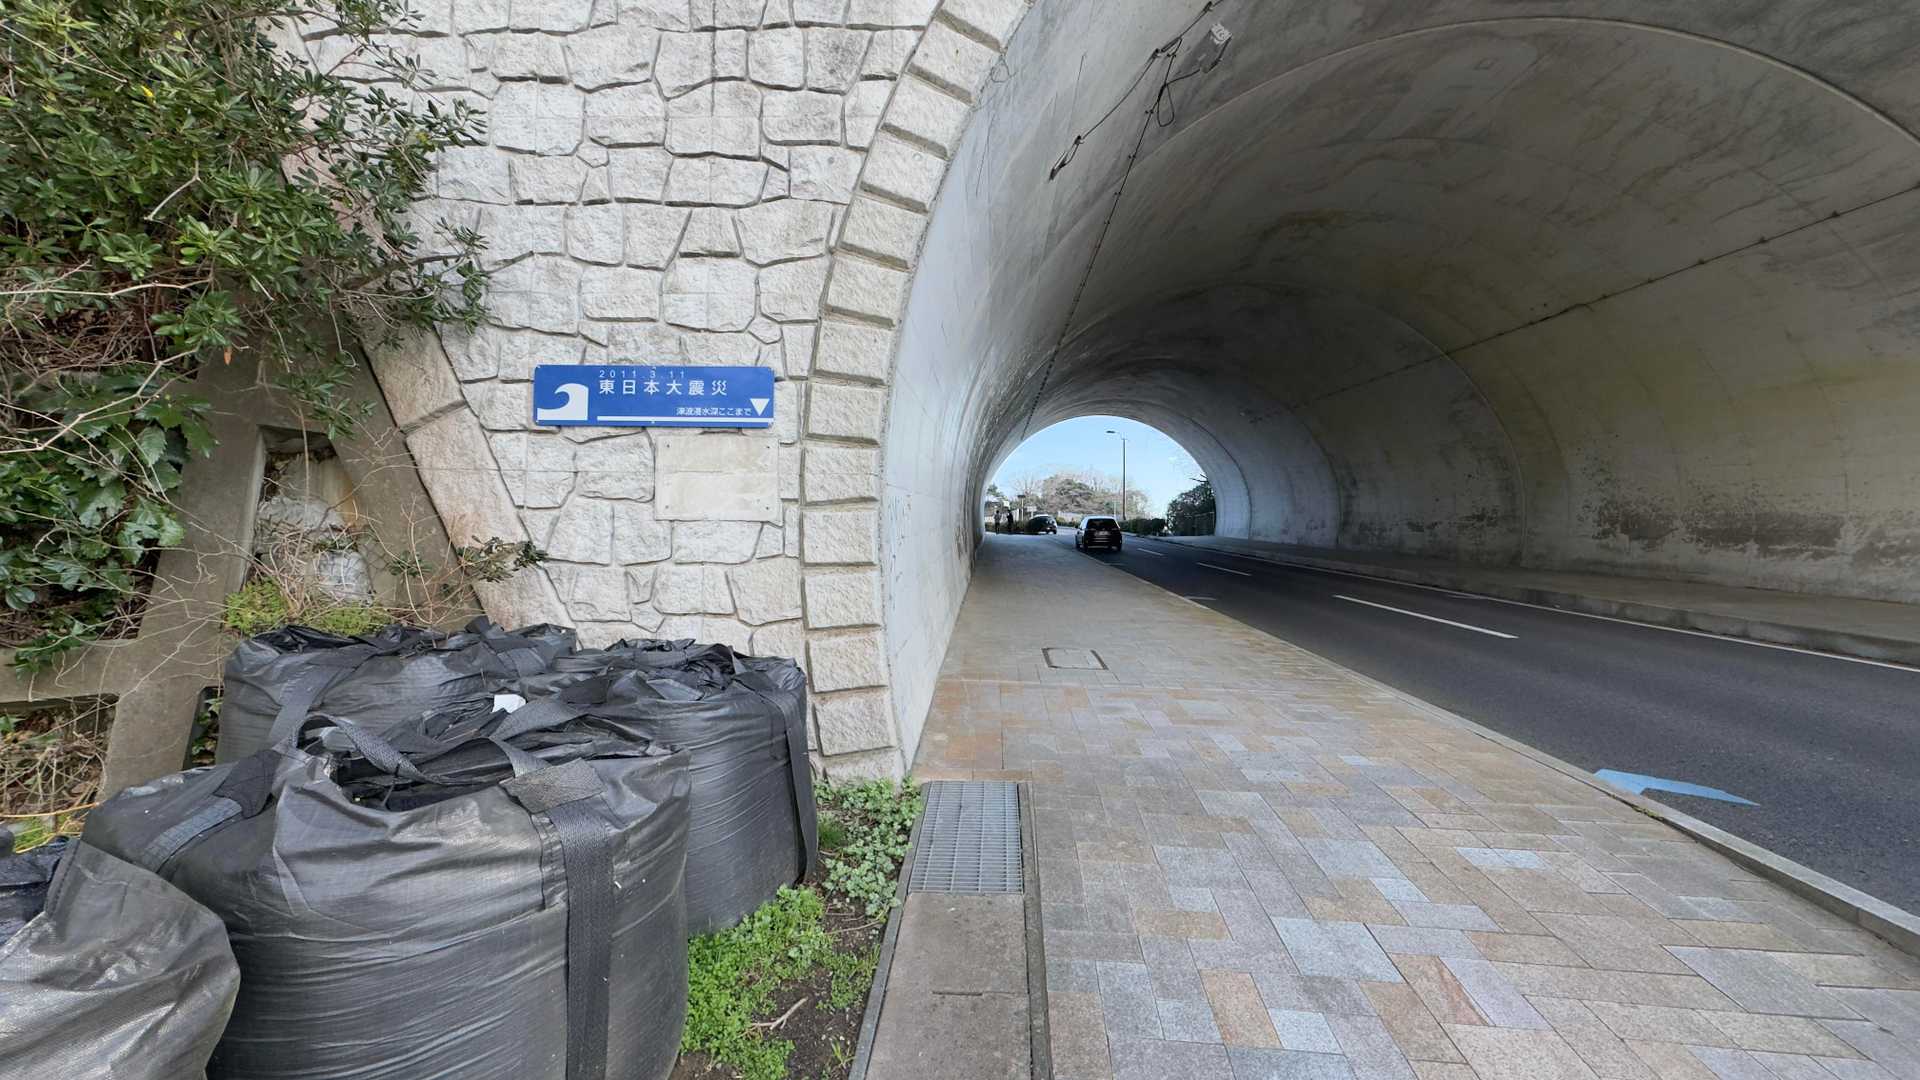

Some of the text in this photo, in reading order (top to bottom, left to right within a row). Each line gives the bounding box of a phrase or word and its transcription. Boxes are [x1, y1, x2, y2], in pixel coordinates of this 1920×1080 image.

[599, 379, 727, 396] 東日本大震災
